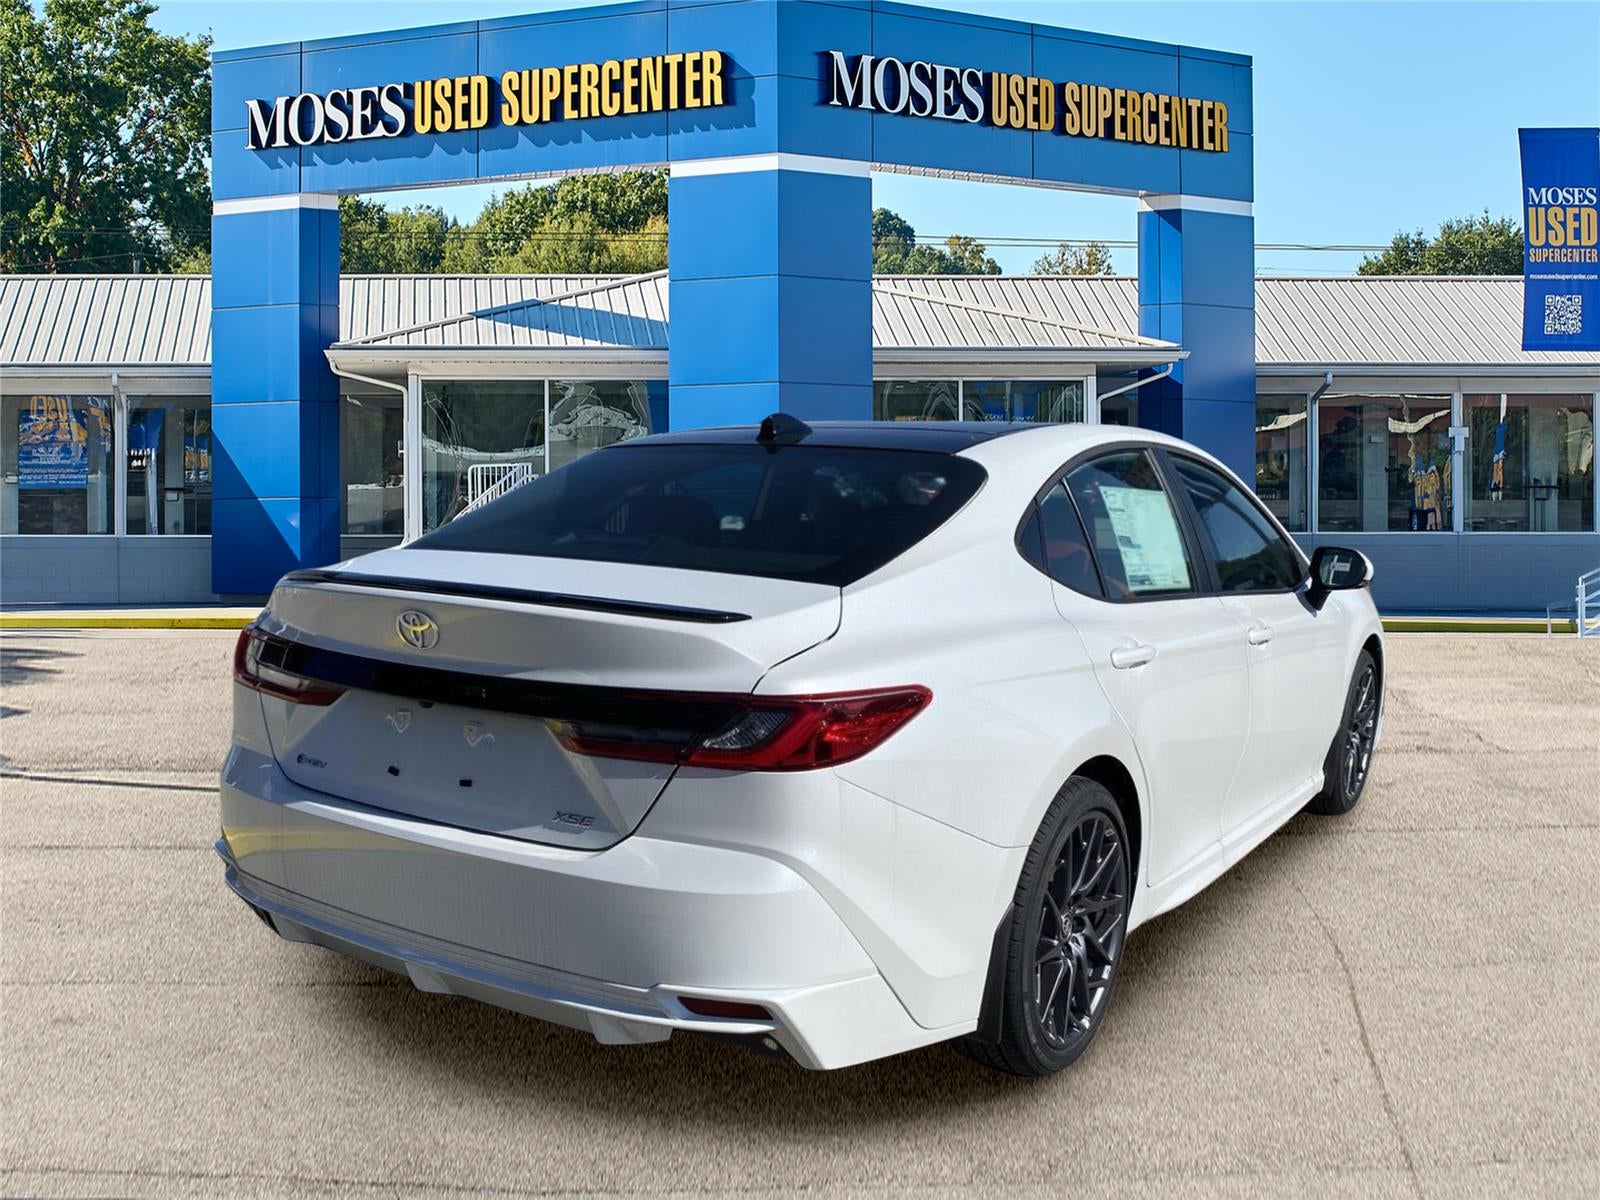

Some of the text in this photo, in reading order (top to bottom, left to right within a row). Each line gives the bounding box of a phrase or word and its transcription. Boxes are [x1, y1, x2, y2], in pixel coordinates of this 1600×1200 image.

[244, 49, 725, 151] MOSES USED SUPERCENTER
[829, 49, 1230, 153] MOSES USED SUPERCENTER
[1527, 187, 1597, 206] MOSES
[1528, 206, 1598, 247] USED
[1529, 247, 1598, 263] SUPERCENTER
[552, 810, 595, 827] XSE
